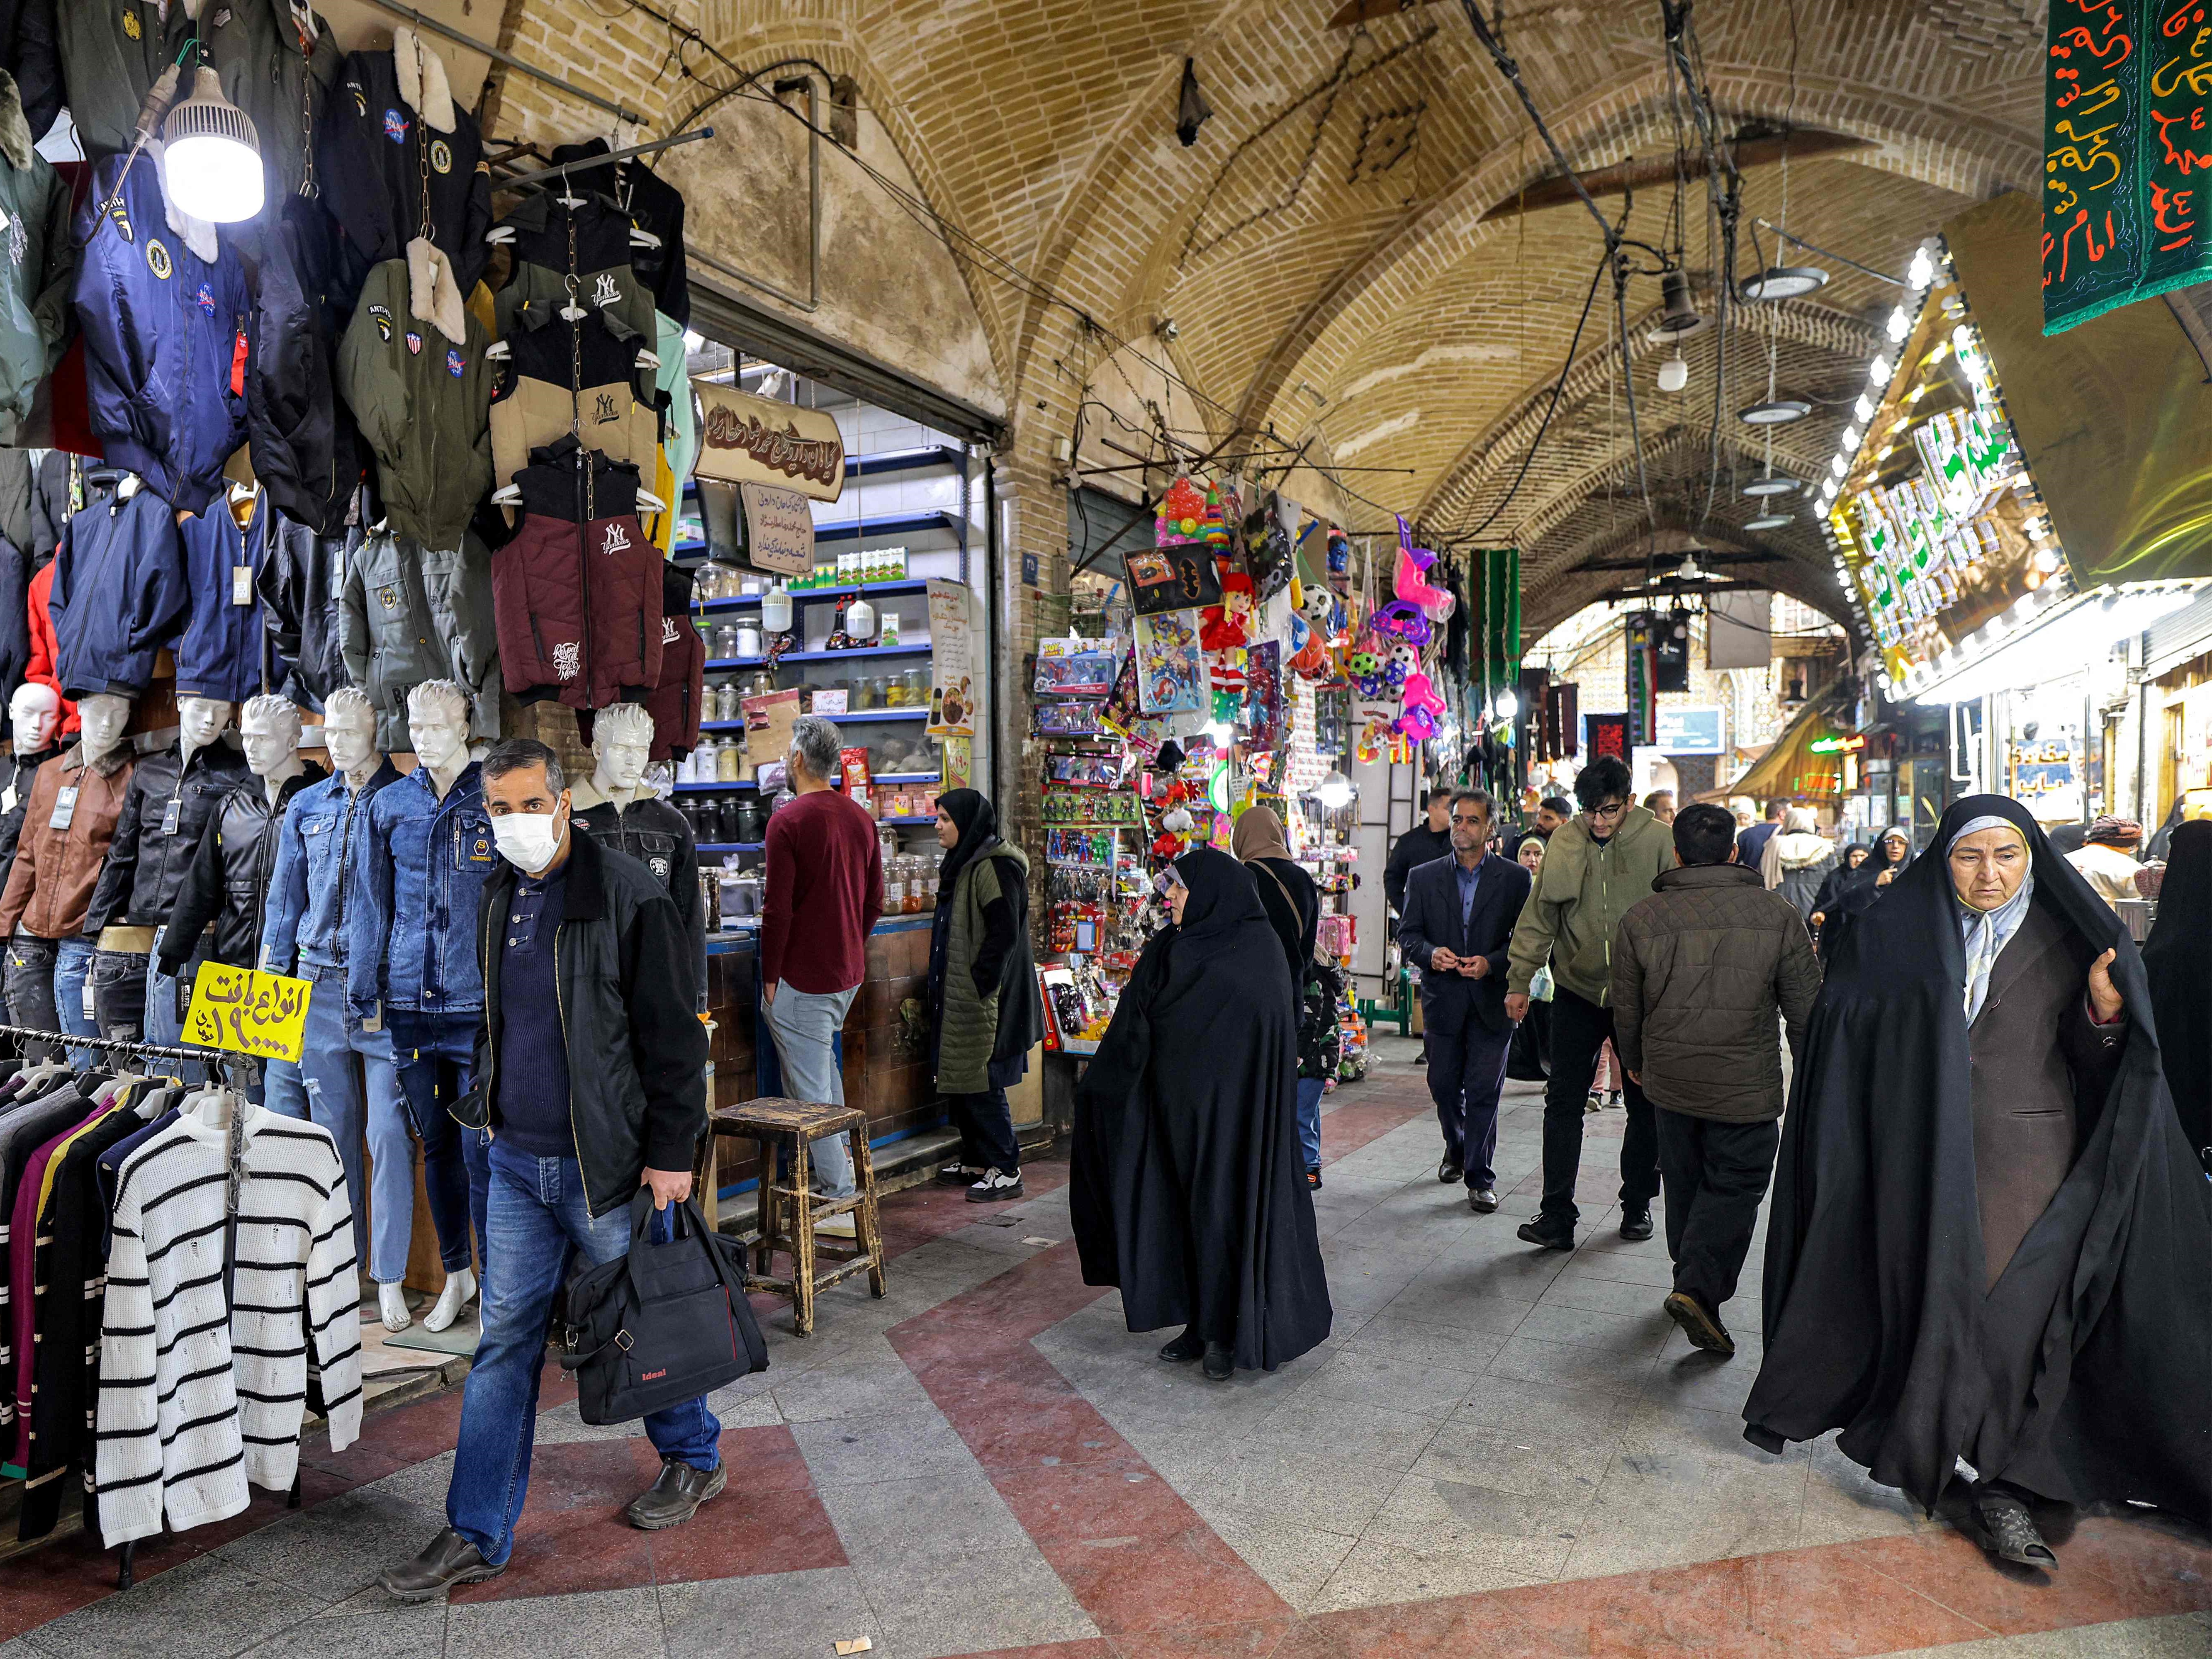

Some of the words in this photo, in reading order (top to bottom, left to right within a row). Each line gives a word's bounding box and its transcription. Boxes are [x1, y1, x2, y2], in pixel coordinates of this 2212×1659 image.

[591, 290, 620, 307] Yankees
[590, 410, 619, 425] Yankees
[601, 538, 630, 554] Yankees
[791, 542, 805, 563] شعبه
[1043, 642, 1061, 652] TOY
[205, 971, 255, 1017] بافت
[252, 979, 306, 1026] انواع
[642, 1368, 666, 1381] Ideal
